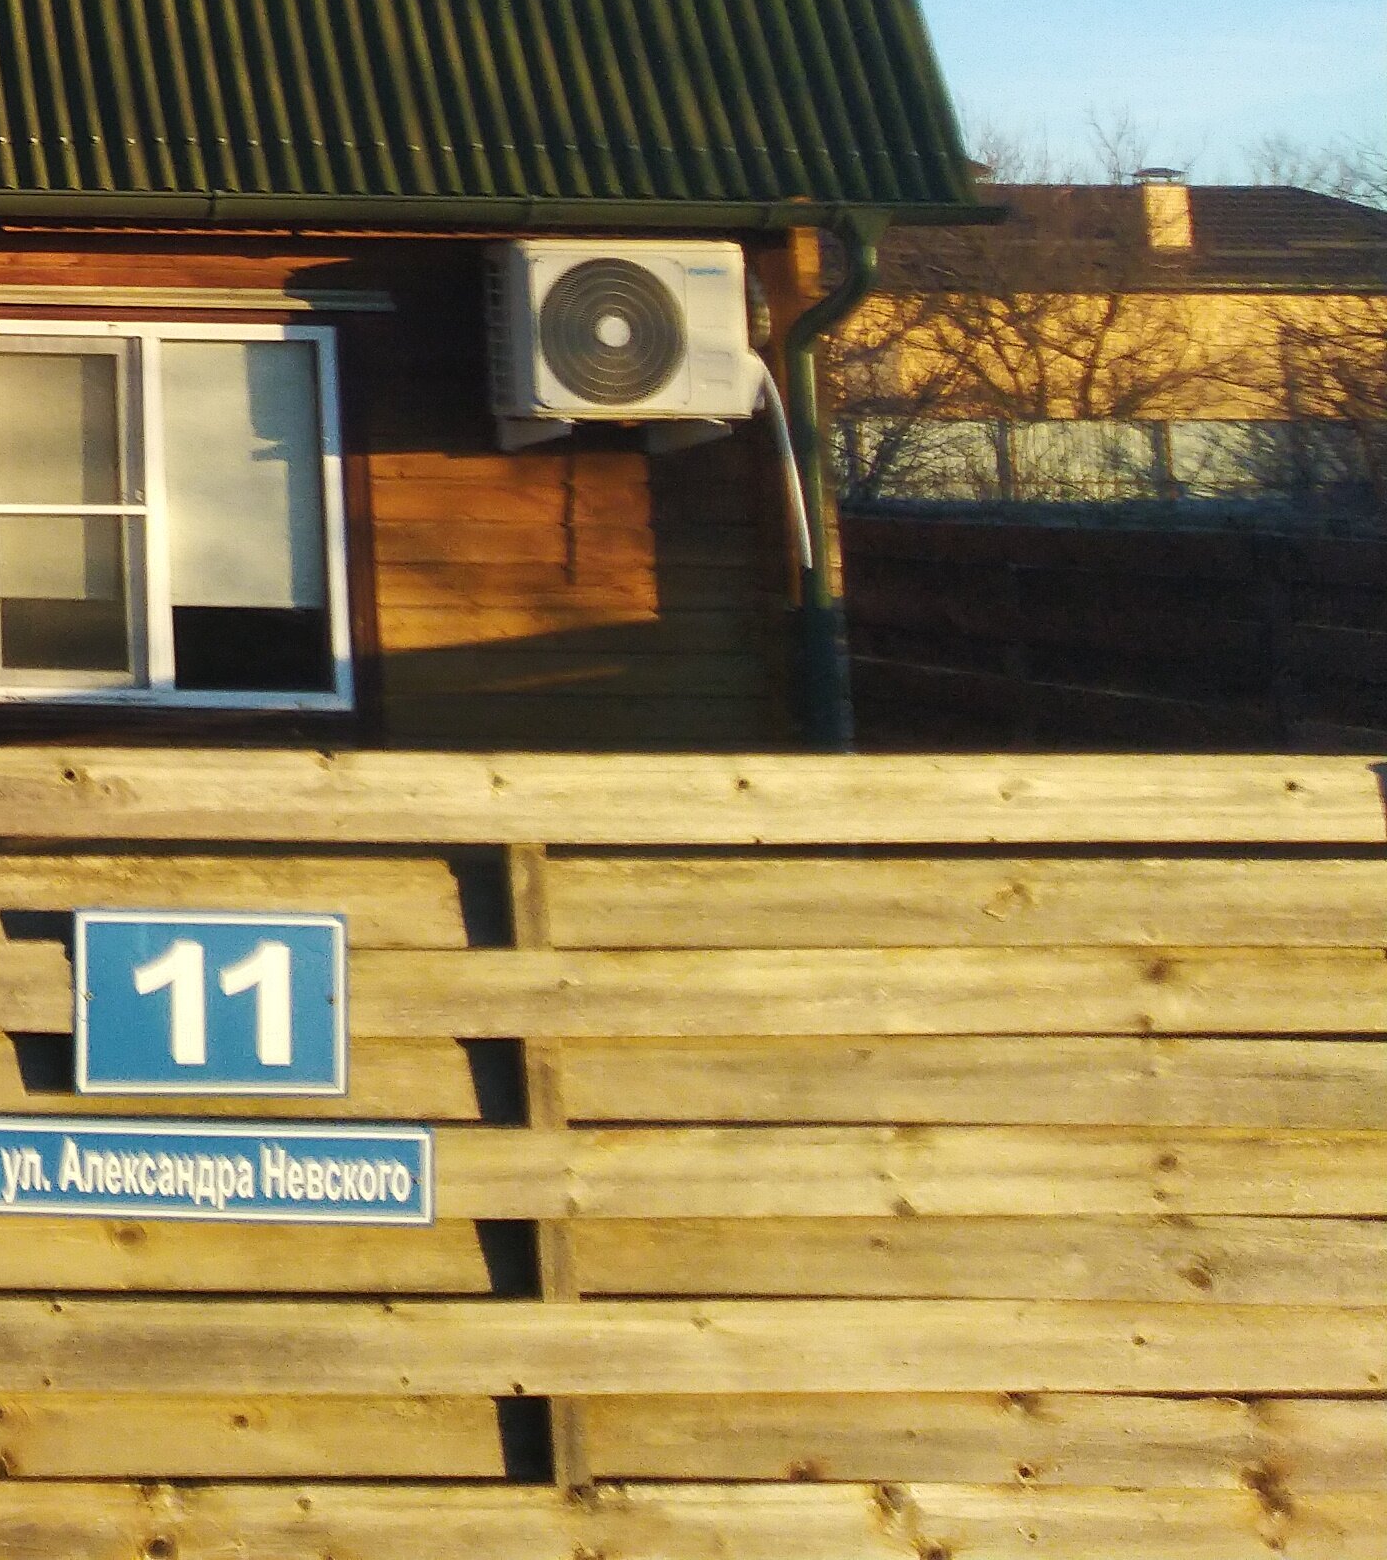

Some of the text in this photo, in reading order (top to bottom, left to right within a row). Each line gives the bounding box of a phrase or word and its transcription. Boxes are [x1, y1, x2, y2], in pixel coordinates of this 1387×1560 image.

[134, 940, 293, 1066] 11
[0, 1136, 412, 1211] ул. Александра Невского
